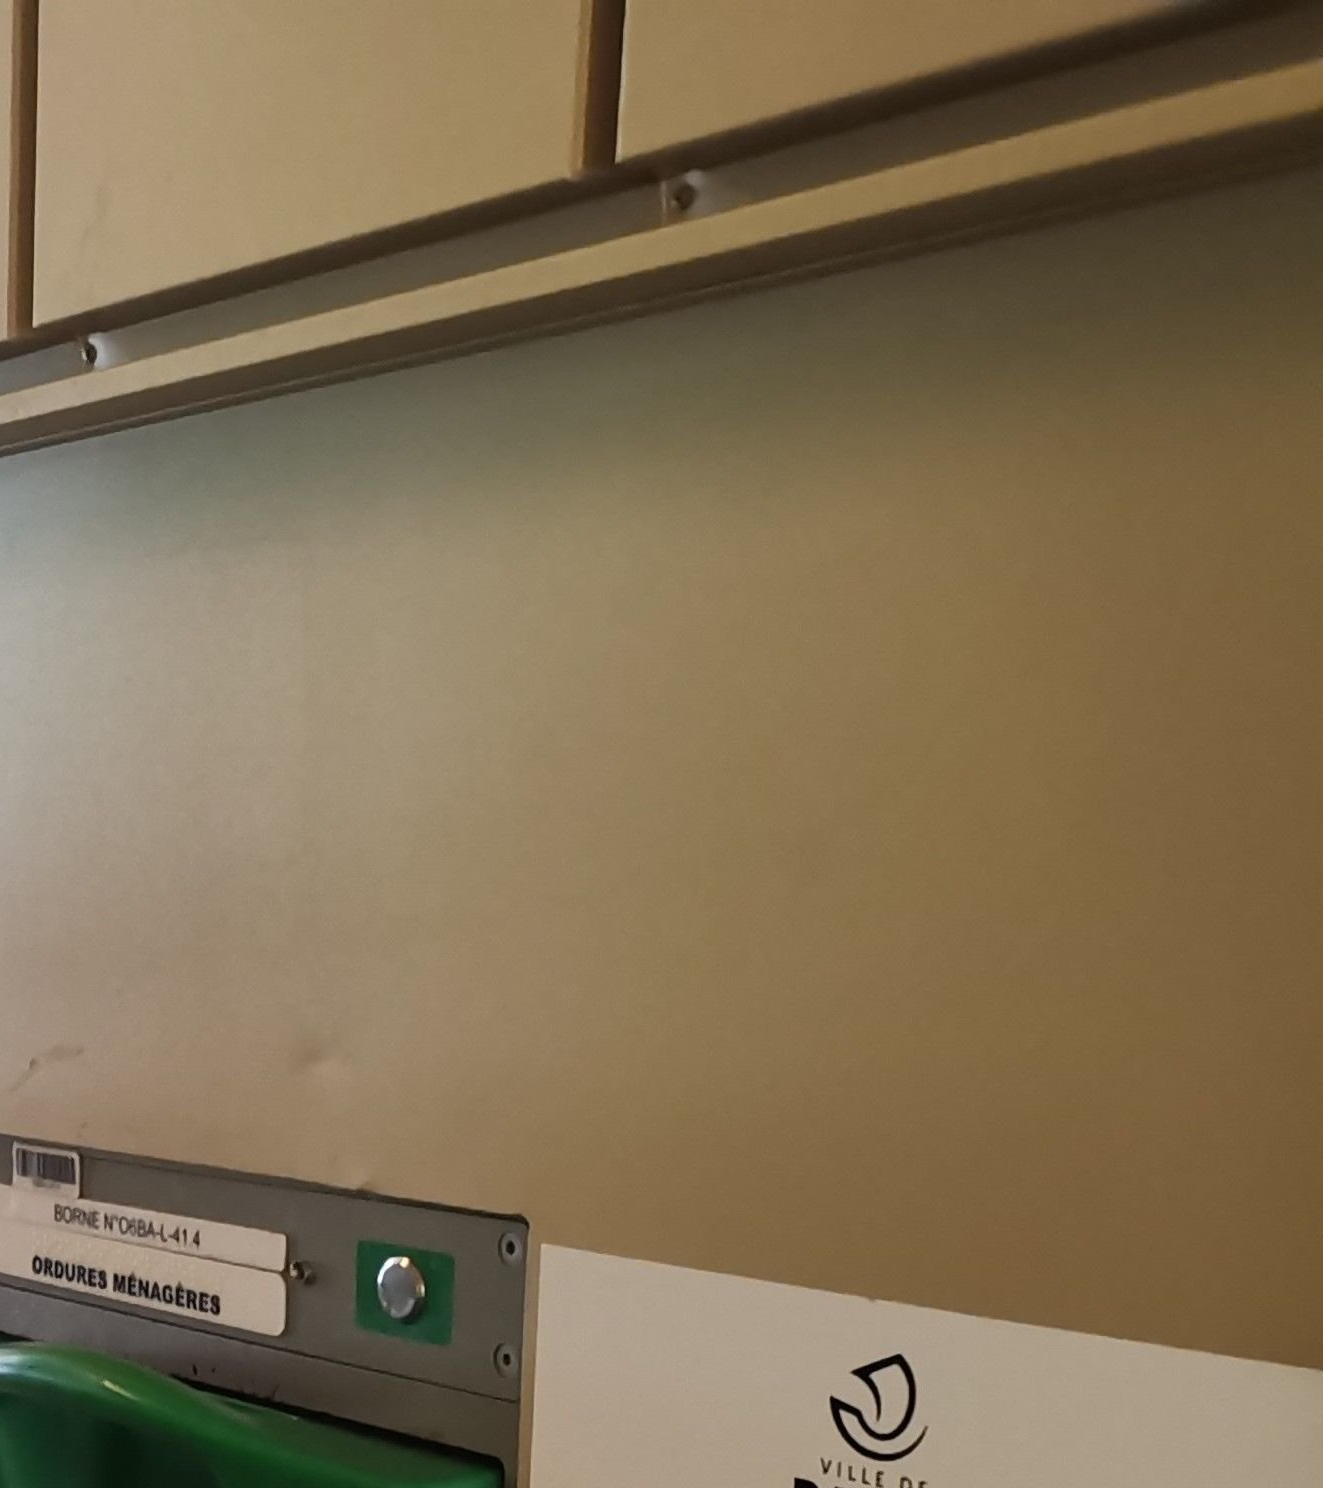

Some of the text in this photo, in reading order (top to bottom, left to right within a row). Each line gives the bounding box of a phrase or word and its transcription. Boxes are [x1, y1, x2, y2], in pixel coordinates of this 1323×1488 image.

[54, 1203, 100, 1231] BORNE
[32, 1254, 221, 1316] ORDURES MÉNAGÈRES
